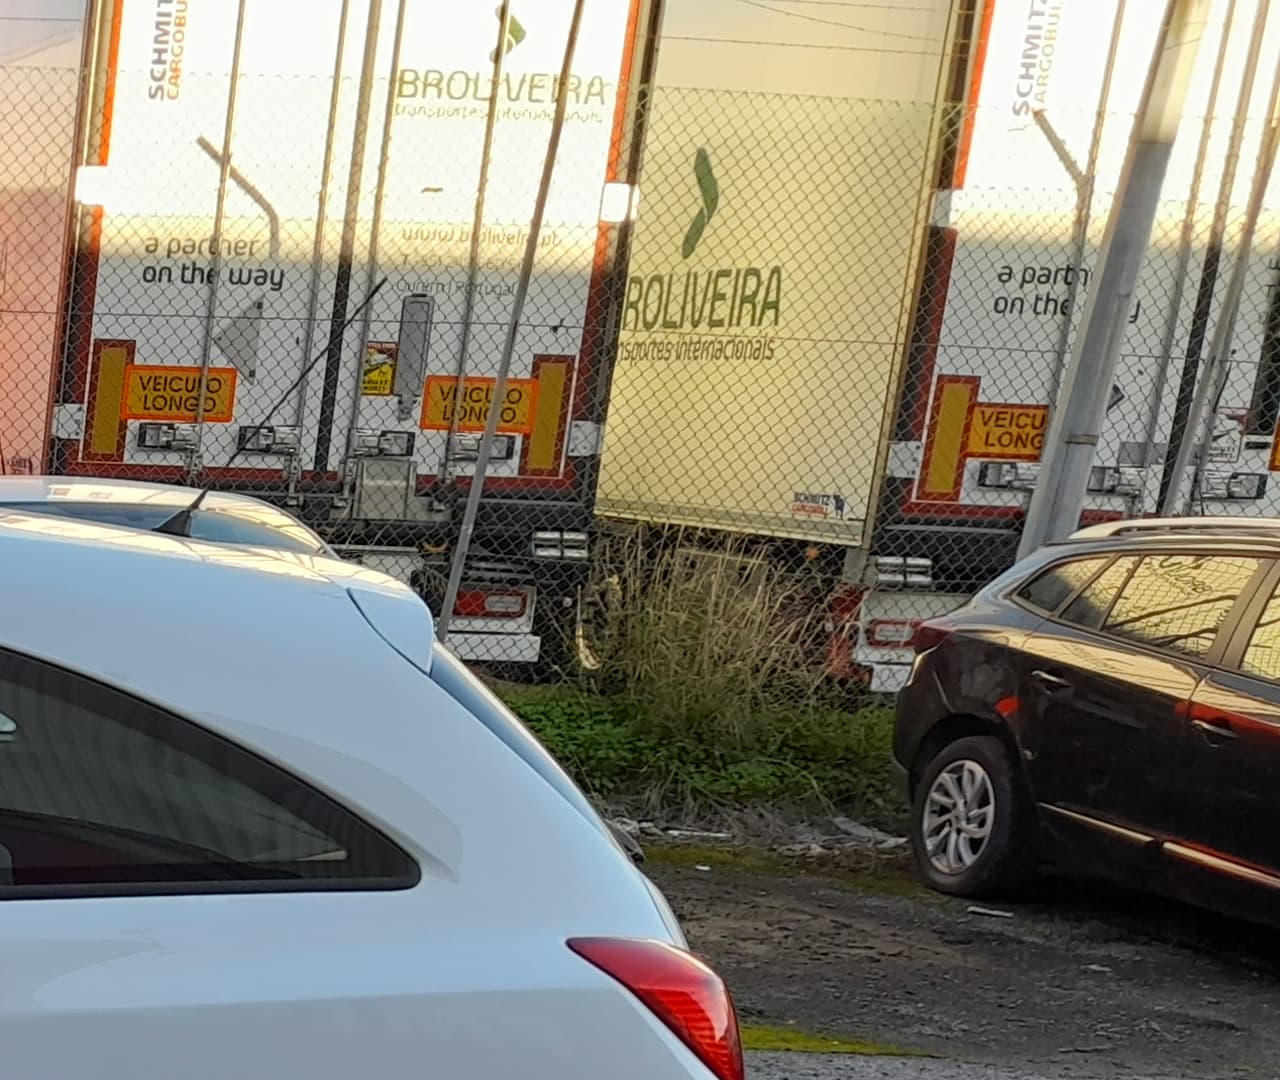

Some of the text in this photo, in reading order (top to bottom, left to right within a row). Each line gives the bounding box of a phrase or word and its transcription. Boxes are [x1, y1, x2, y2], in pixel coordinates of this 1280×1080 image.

[397, 69, 606, 105] BROLVEIRA
[144, 237, 159, 255] a
[143, 262, 285, 291] on the way
[997, 264, 1089, 288] a partn
[994, 295, 1025, 314] on
[142, 395, 217, 412] LONGO
[980, 410, 1046, 430] VEICU
[984, 431, 1044, 450] LONG
